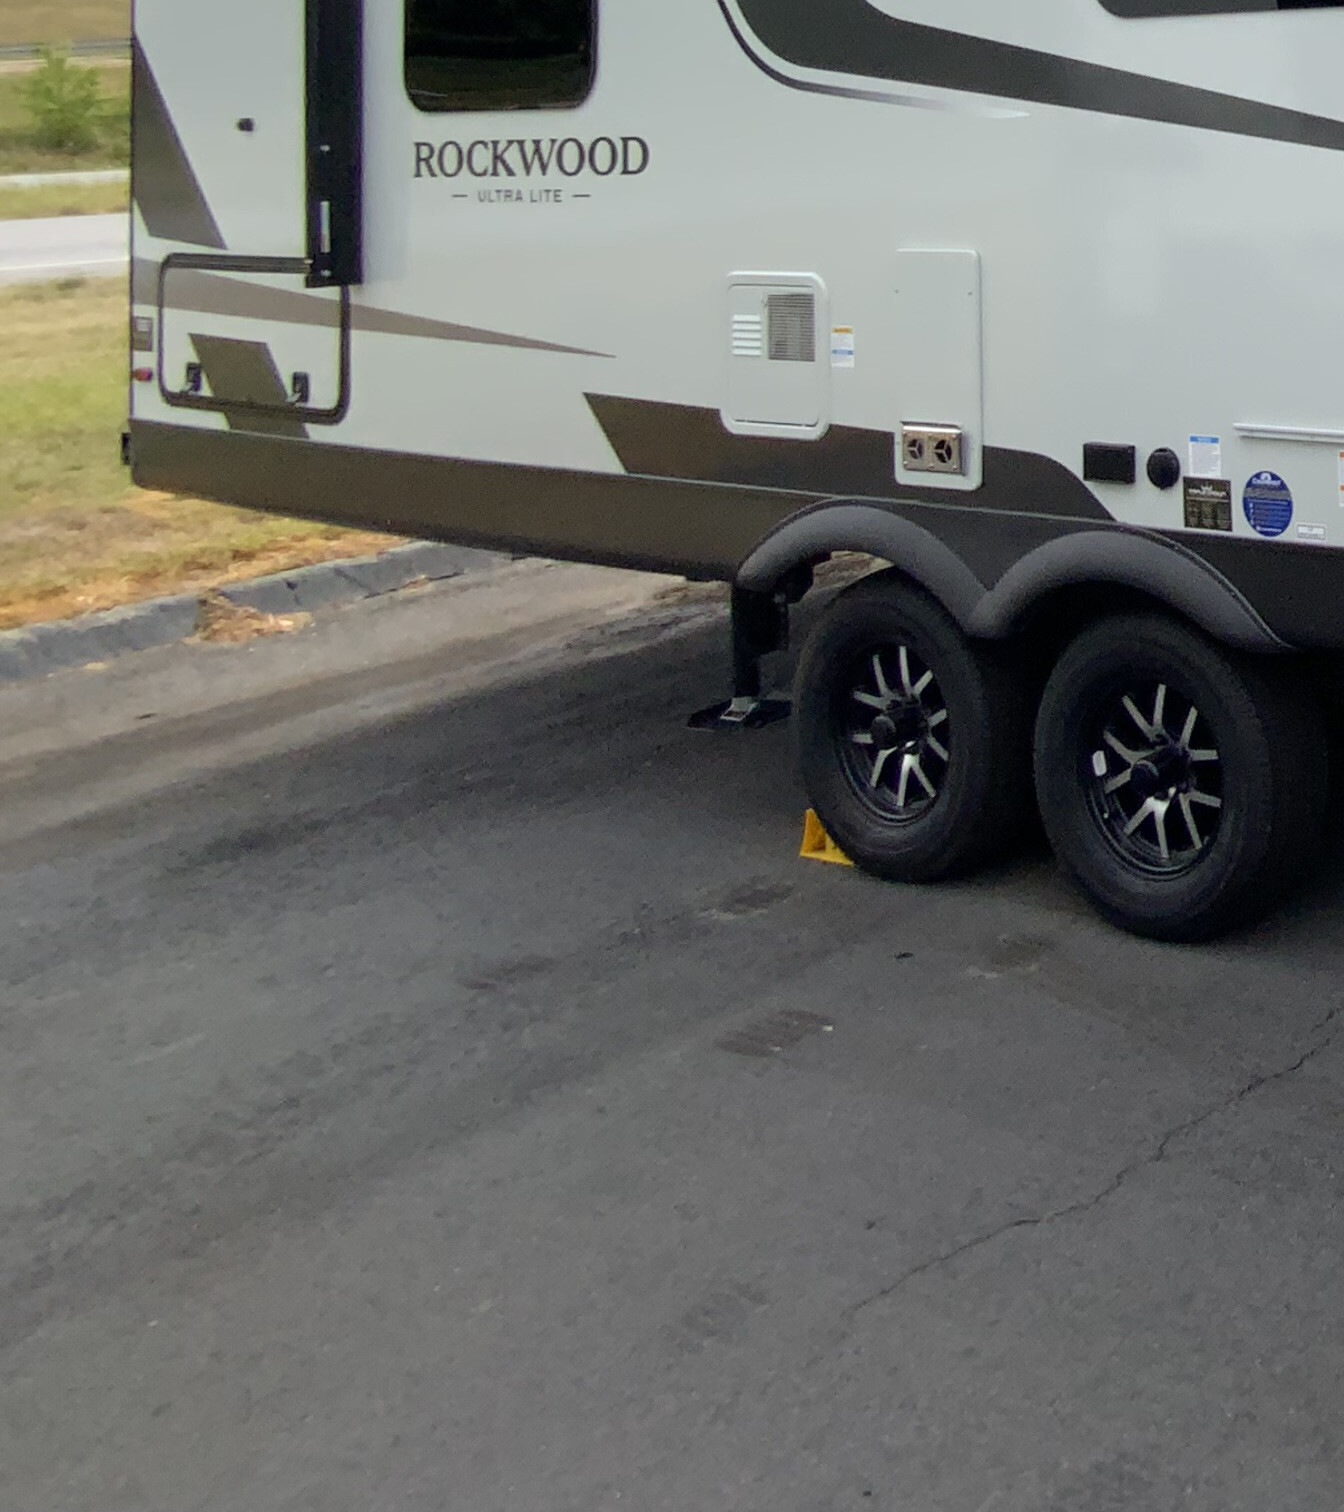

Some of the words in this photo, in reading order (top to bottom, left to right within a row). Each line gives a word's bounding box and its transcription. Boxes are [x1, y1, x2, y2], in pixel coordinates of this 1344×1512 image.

[413, 135, 650, 178] ROCKWOOD
[477, 189, 523, 203] ULTRA
[529, 188, 563, 203] LITE
